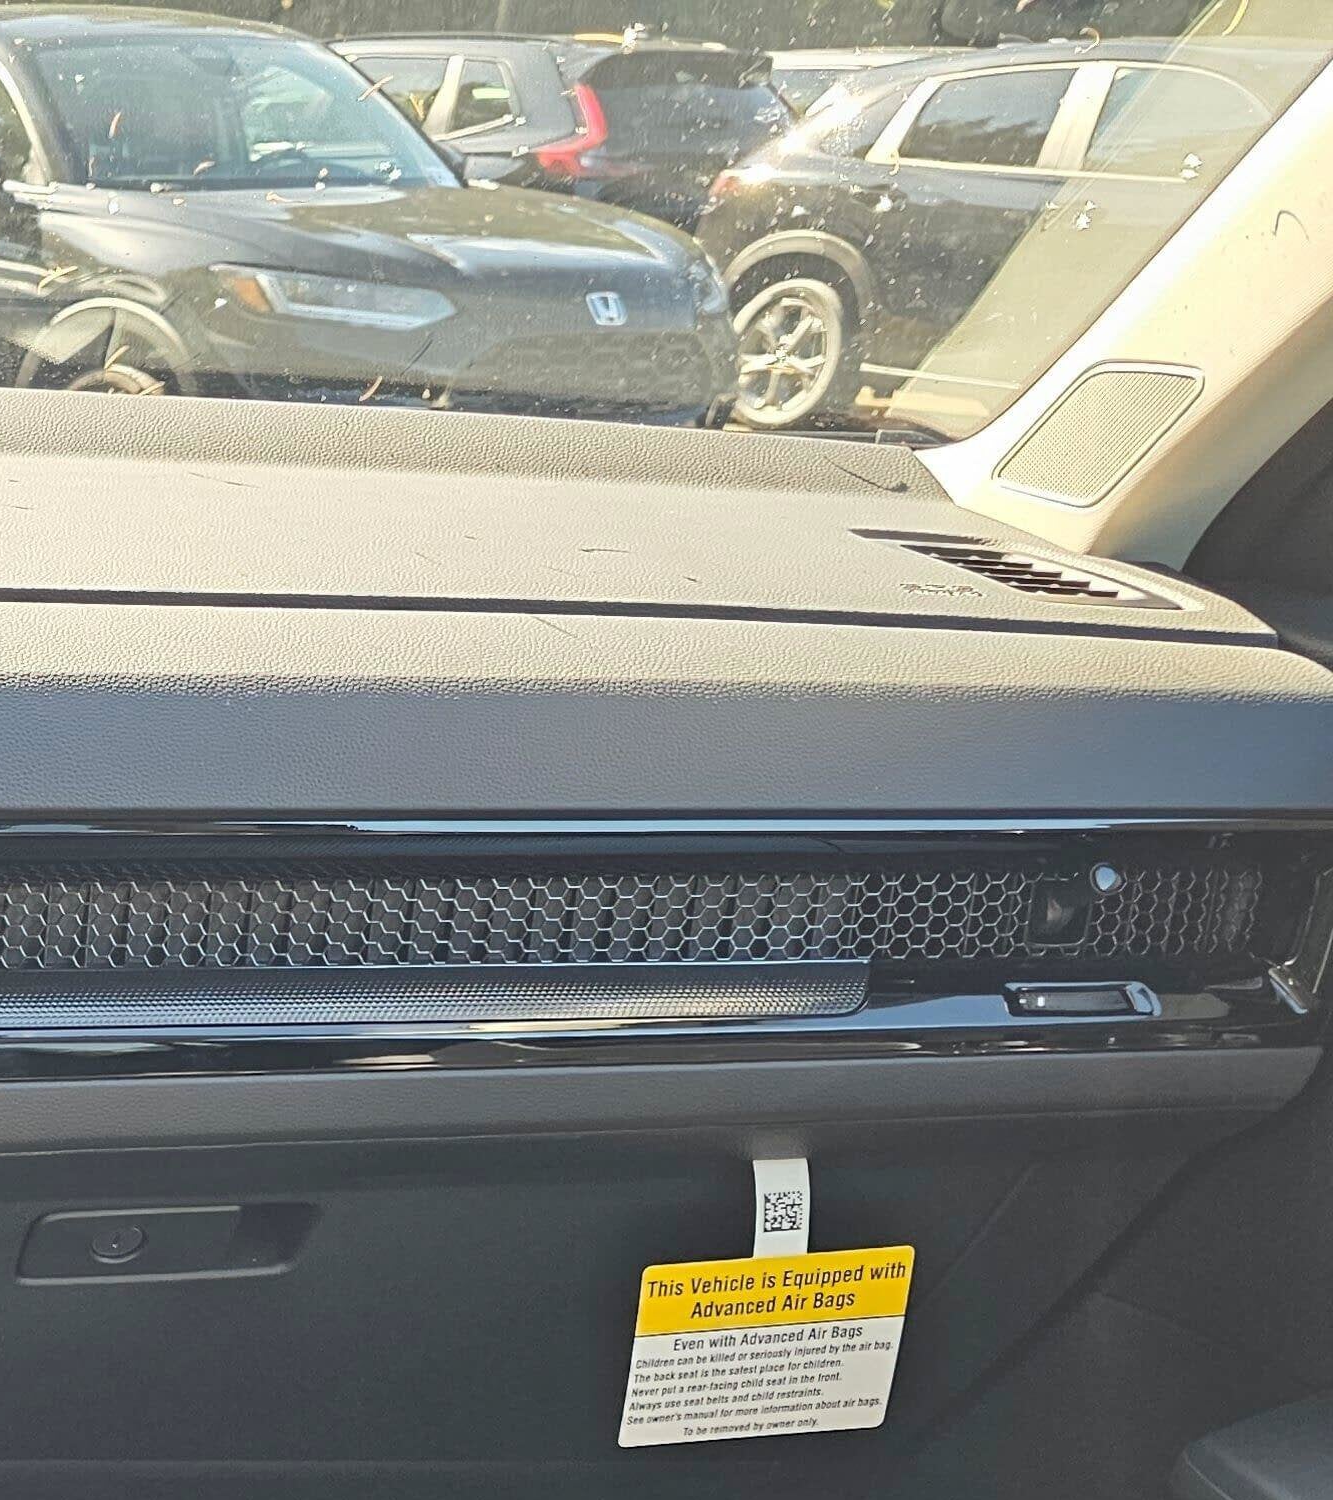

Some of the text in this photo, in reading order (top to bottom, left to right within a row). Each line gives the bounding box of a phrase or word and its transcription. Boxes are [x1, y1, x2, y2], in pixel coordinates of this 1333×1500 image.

[648, 1262, 906, 1298] This Vehicle is Equipped with
[689, 1291, 855, 1319] Advanced Air Bags
[673, 1325, 863, 1352] Even with Advanced Air Bags
[635, 1340, 893, 1370] Children can be killed or seriously injured by the air bag.
[634, 1358, 844, 1384] The back seat is the safest place for children.
[631, 1387, 659, 1398] Never
[661, 1385, 677, 1397] put
[687, 1380, 739, 1393] rear-facing
[741, 1377, 764, 1389] child
[766, 1375, 787, 1387] seat
[789, 1374, 799, 1385] in
[800, 1373, 815, 1384] the
[818, 1372, 842, 1383] front.
[627, 1396, 882, 1426] See owner's manual for more information about air bags.
[628, 1400, 662, 1413] Always
[664, 1399, 681, 1409] use
[683, 1397, 704, 1408] seat
[706, 1394, 729, 1406] belts
[731, 1392, 750, 1404] and
[751, 1389, 775, 1401] child
[683, 1426, 694, 1437] To
[696, 1425, 708, 1435] be
[709, 1422, 751, 1435] removed
[753, 1421, 765, 1432] by
[766, 1418, 795, 1430] owner
